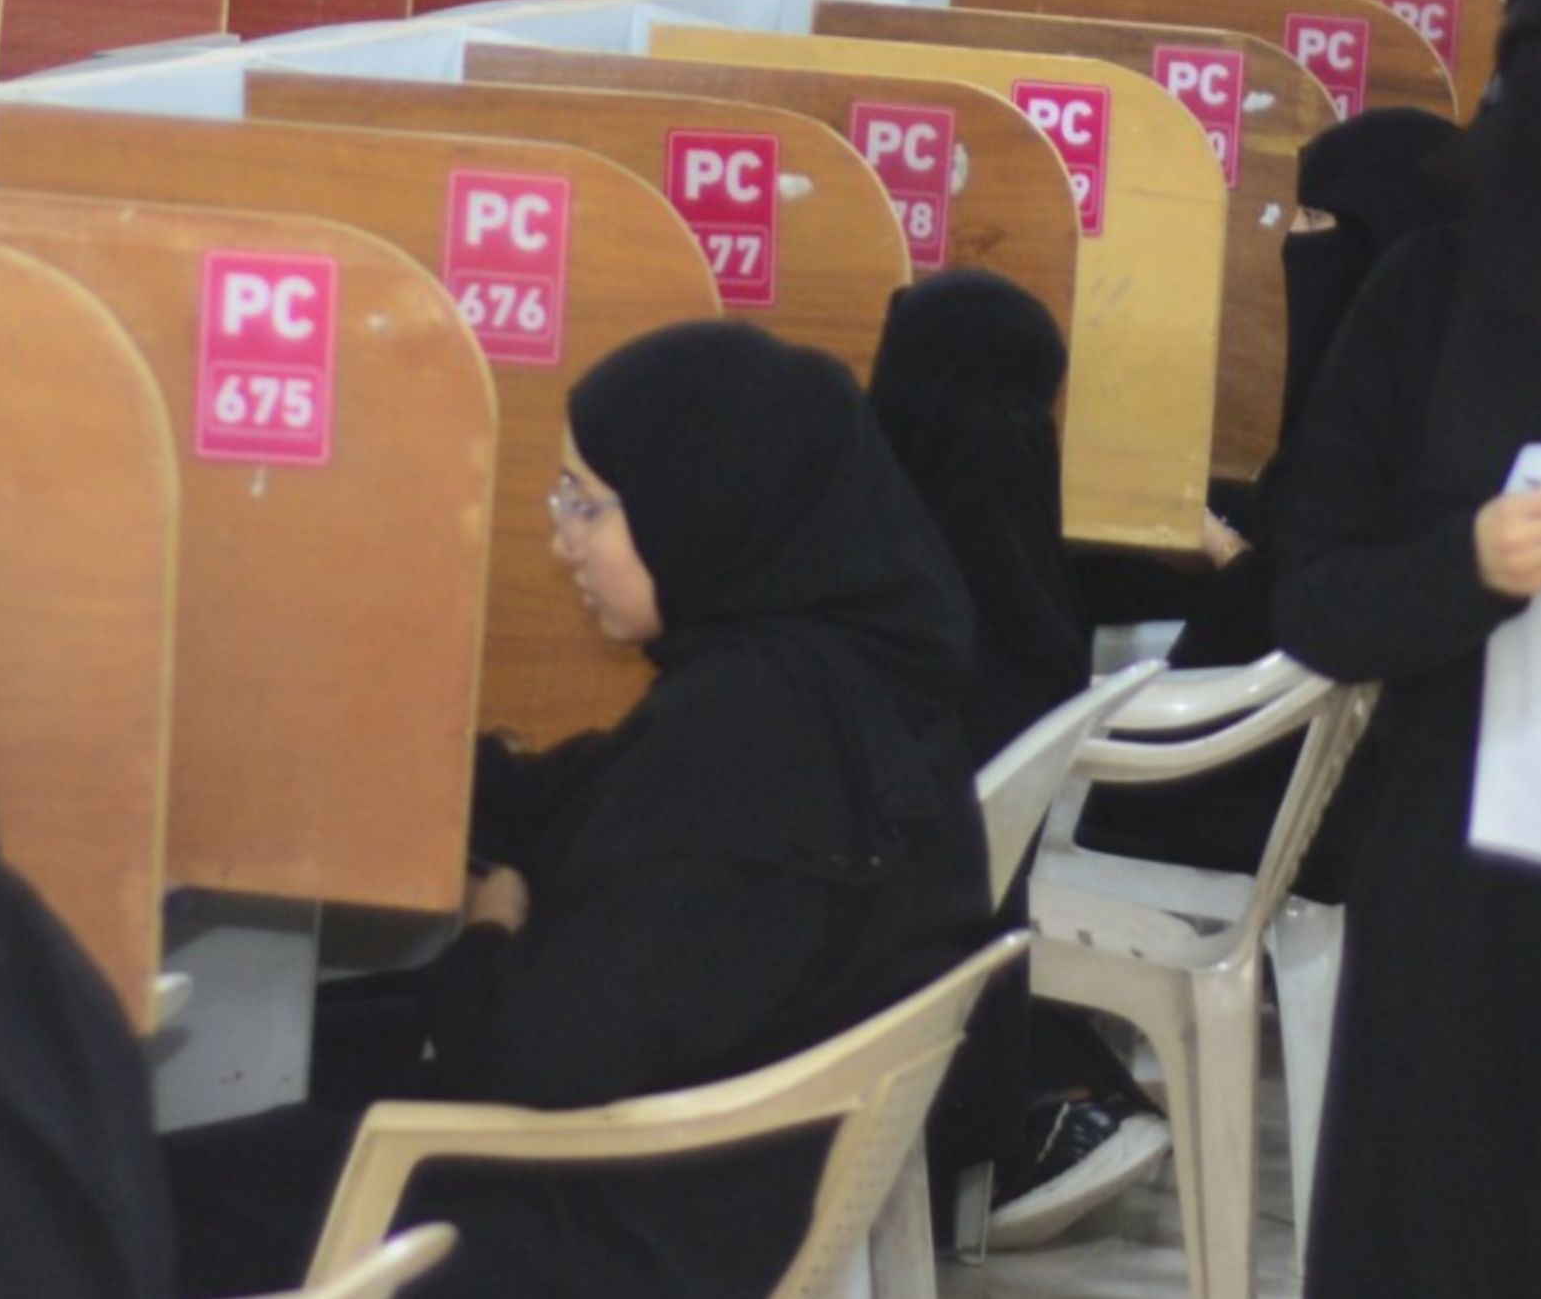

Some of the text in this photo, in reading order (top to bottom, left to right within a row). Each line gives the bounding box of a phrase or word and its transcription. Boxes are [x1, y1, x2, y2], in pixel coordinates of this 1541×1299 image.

[1298, 27, 1355, 69] PC
[1168, 60, 1229, 105] PC
[866, 120, 937, 171] PC
[1028, 98, 1092, 146] PC
[685, 148, 762, 203] PC
[465, 191, 550, 251] PC
[696, 234, 762, 276] 77
[222, 272, 317, 340] PC
[460, 282, 546, 333] 676
[214, 375, 313, 429] 675
